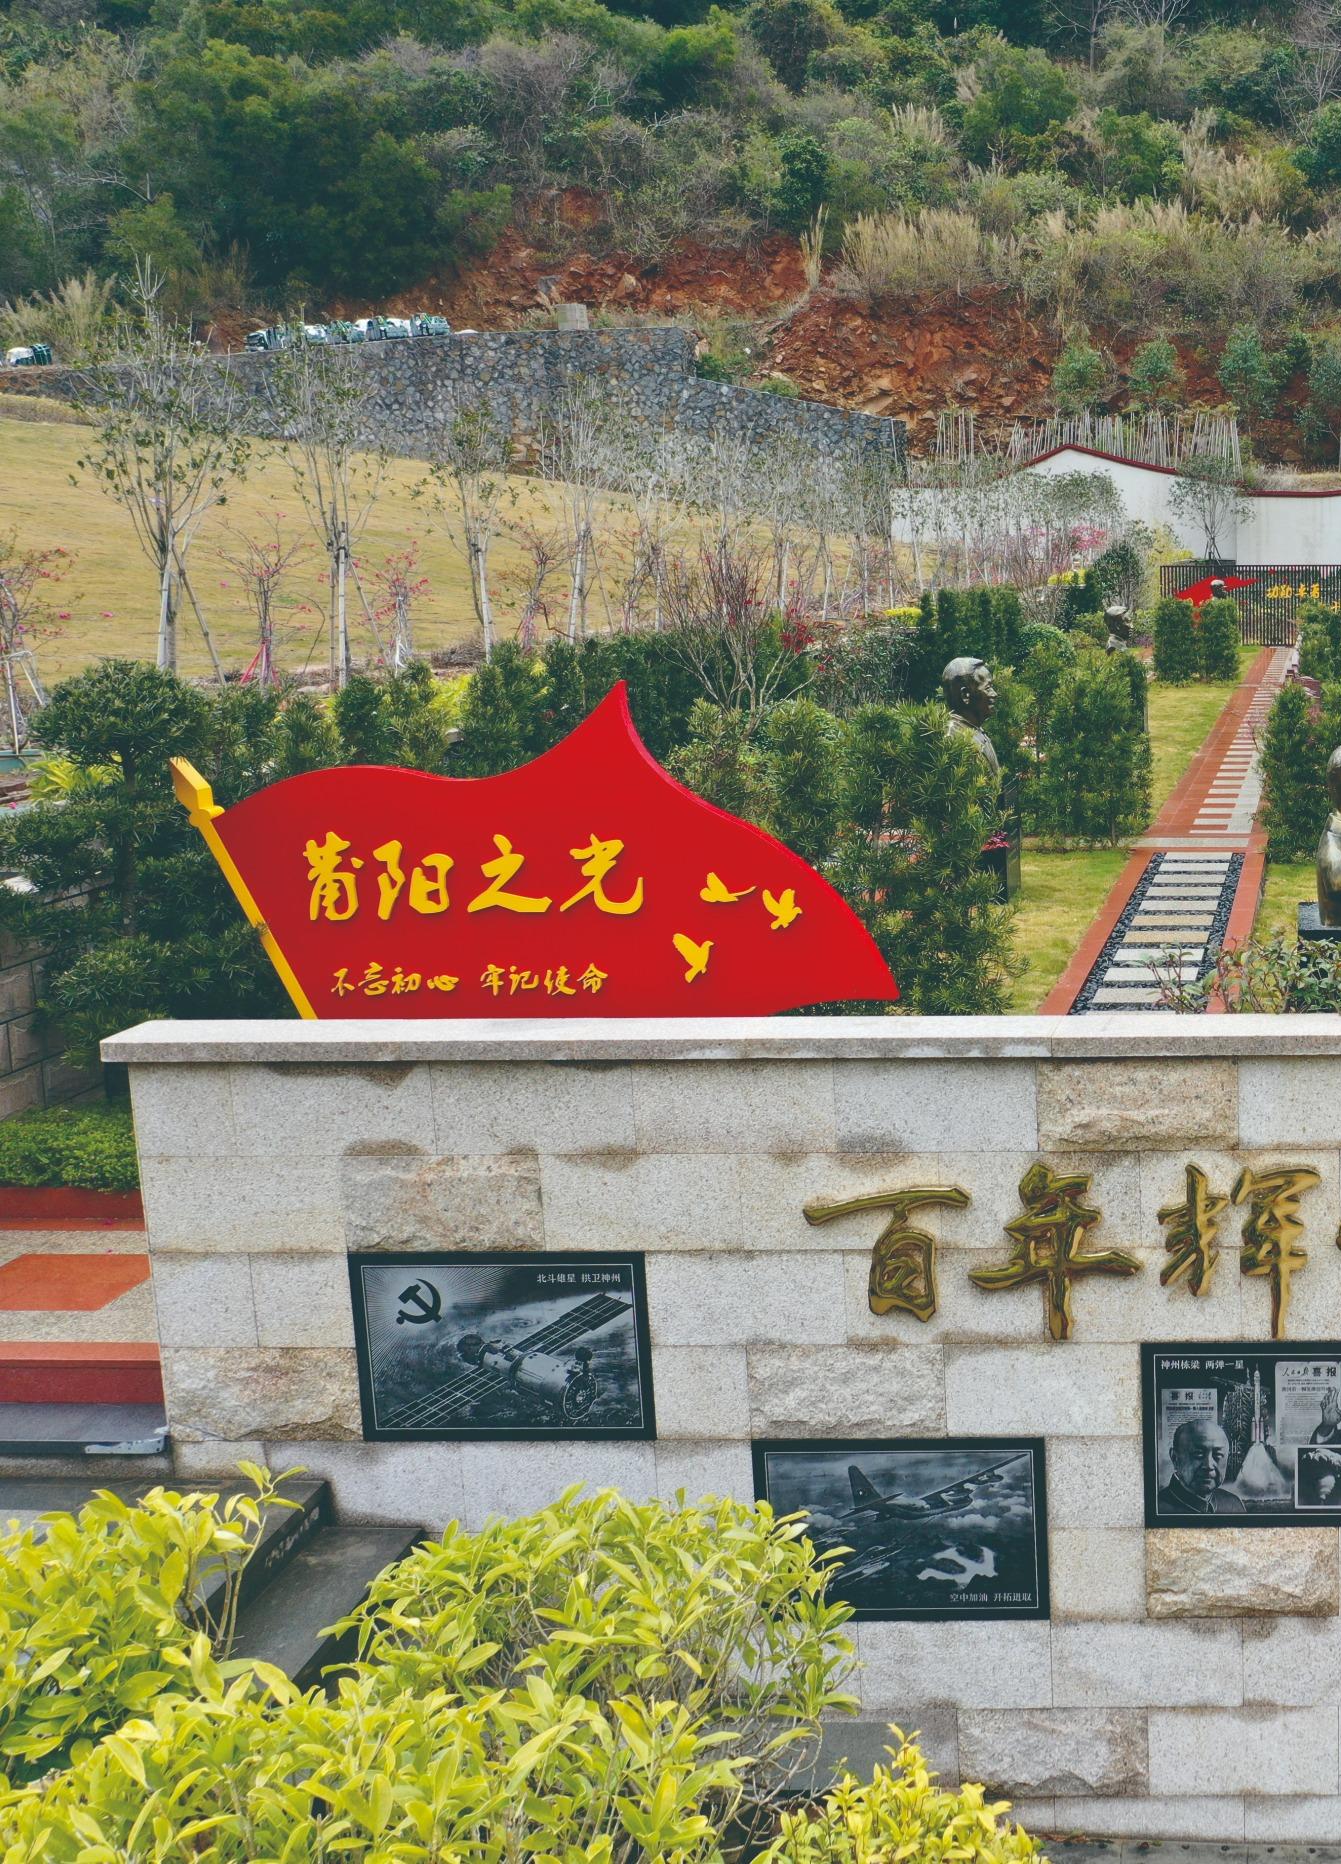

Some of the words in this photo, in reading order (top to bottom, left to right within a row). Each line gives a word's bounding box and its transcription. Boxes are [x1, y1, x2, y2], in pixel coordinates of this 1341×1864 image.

[303, 831, 644, 921] 莆阳之光
[330, 961, 459, 997] 不忘初心
[480, 962, 609, 997] 牢记使命
[581, 1272, 621, 1283] 拱卫神州
[1161, 1359, 1201, 1370] 神州栋梁
[1205, 1359, 1245, 1370] 两弹一星
[949, 1592, 988, 1602] 空中加油
[993, 1592, 1032, 1602] 开拓进取
